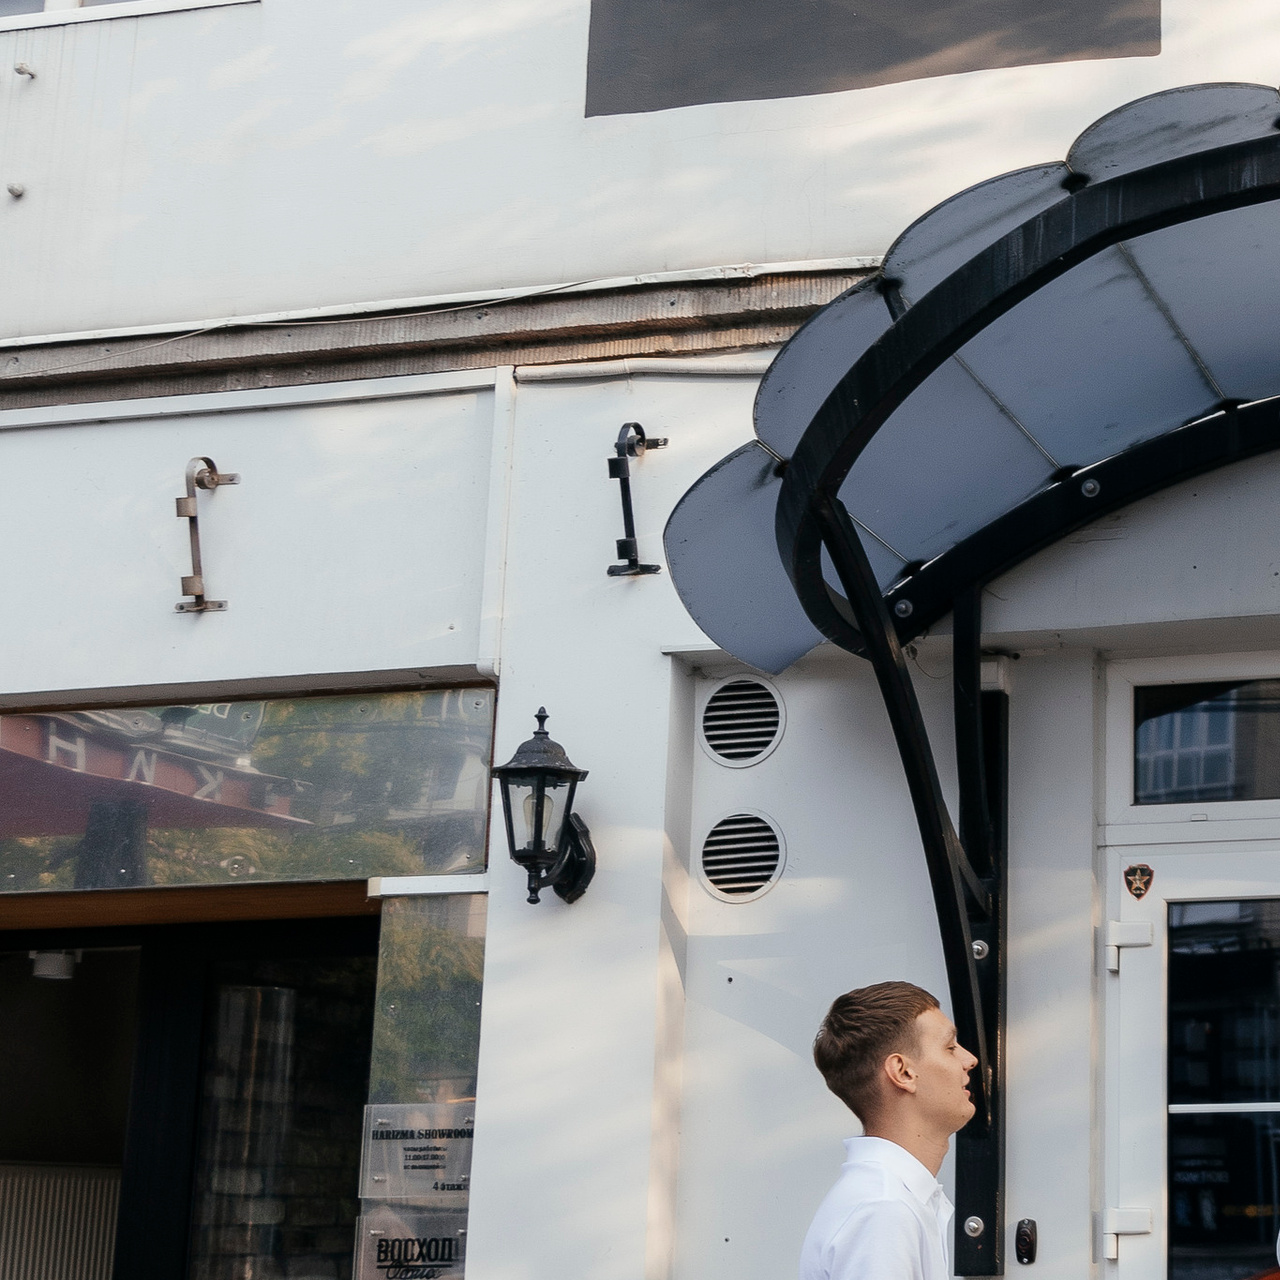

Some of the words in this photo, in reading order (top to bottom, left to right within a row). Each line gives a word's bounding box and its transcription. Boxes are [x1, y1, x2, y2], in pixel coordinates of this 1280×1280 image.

[372, 1129, 415, 1141] HARIZMA
[432, 1181, 439, 1191] 4
[377, 1238, 454, 1263] ВОСХОД
